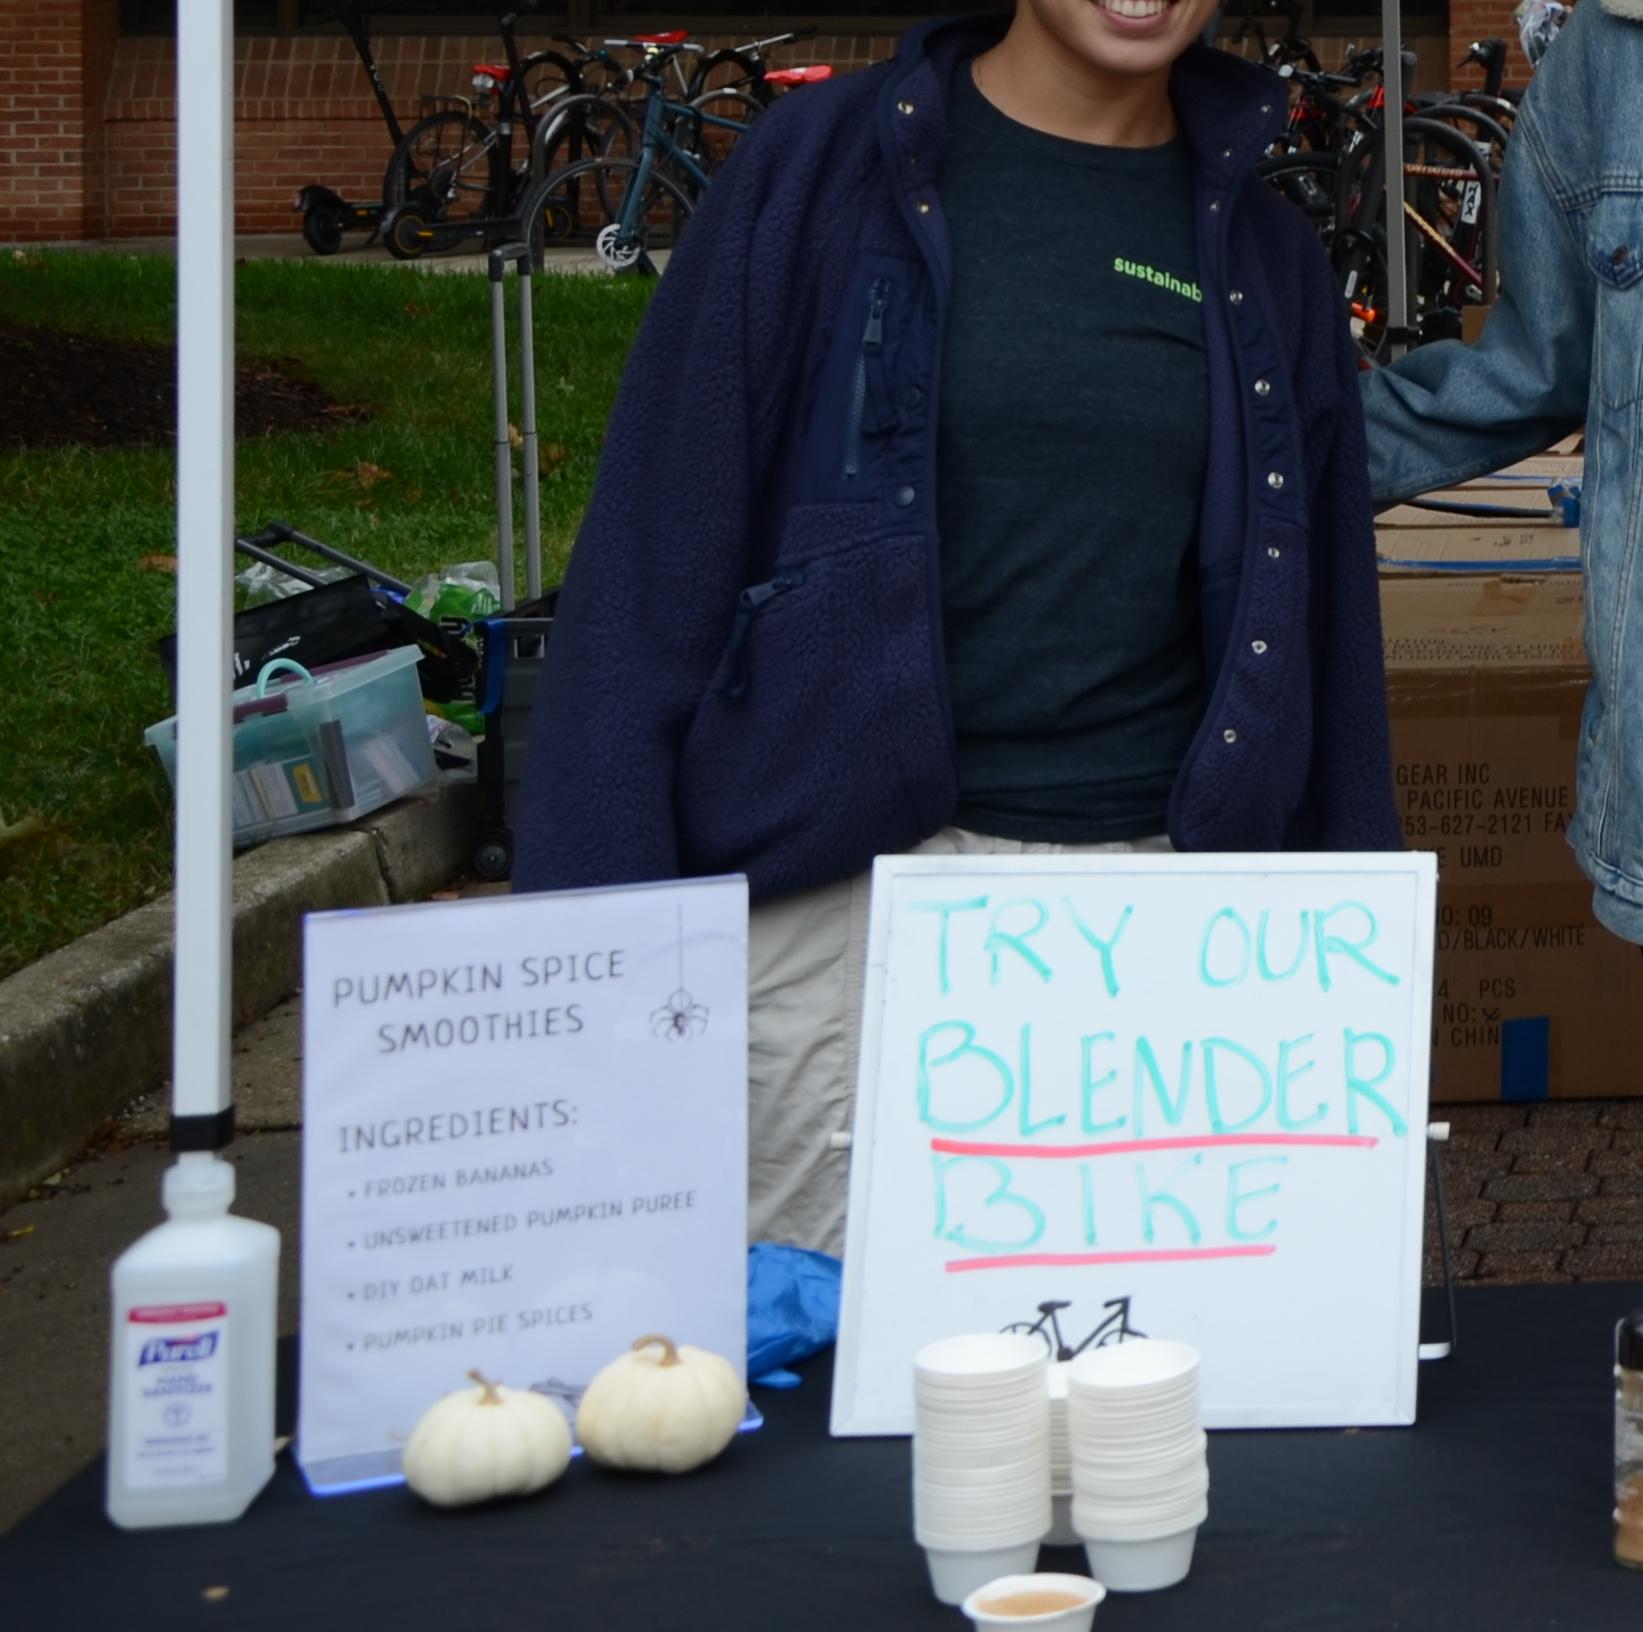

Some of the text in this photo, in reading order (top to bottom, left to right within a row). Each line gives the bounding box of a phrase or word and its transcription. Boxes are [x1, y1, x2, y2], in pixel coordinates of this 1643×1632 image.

[1396, 763, 1490, 786] GEAR INC
[1407, 786, 1569, 810] PACIFIC AVENUE
[1460, 845, 1503, 868] UMD
[1468, 904, 1493, 927] 09
[904, 895, 1400, 997] TRY OUR
[333, 949, 626, 1008] PUMPKIN SPICE
[1479, 977, 1517, 999] PCS
[377, 1003, 585, 1054] SMOOTHIES
[1450, 1024, 1500, 1047] CHIN
[916, 1018, 1409, 1139] BLENDER
[337, 1098, 579, 1154] INGREDIENTS:
[364, 1157, 555, 1199] FROZEN BANANAS
[364, 1189, 697, 1250] UNSWEETENED PUMPKIN PUREE
[930, 1152, 1291, 1252] BIKE
[363, 1264, 515, 1301] DIY OAT MILK
[363, 1302, 594, 1353] PUMPKIN PIE SPICES
